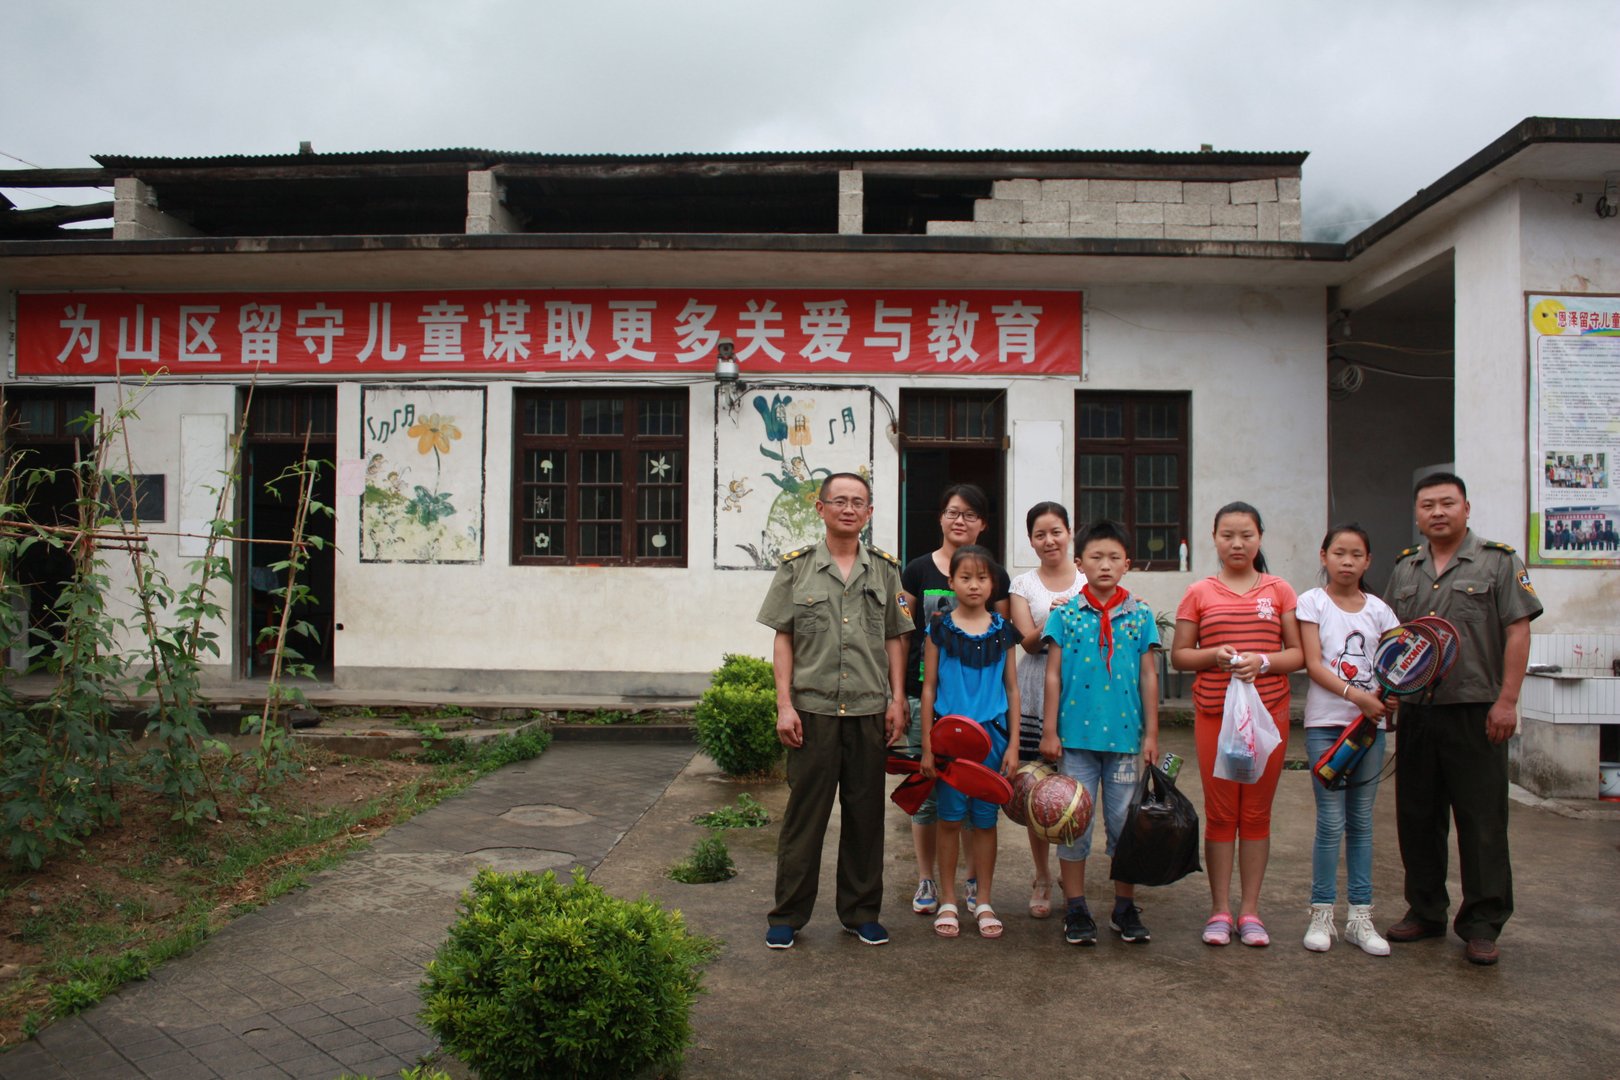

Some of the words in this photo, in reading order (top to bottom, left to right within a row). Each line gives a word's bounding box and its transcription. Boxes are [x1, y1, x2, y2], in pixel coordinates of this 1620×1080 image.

[56, 298, 1044, 364] 为山区留守儿童谋取更多关爱与教育
